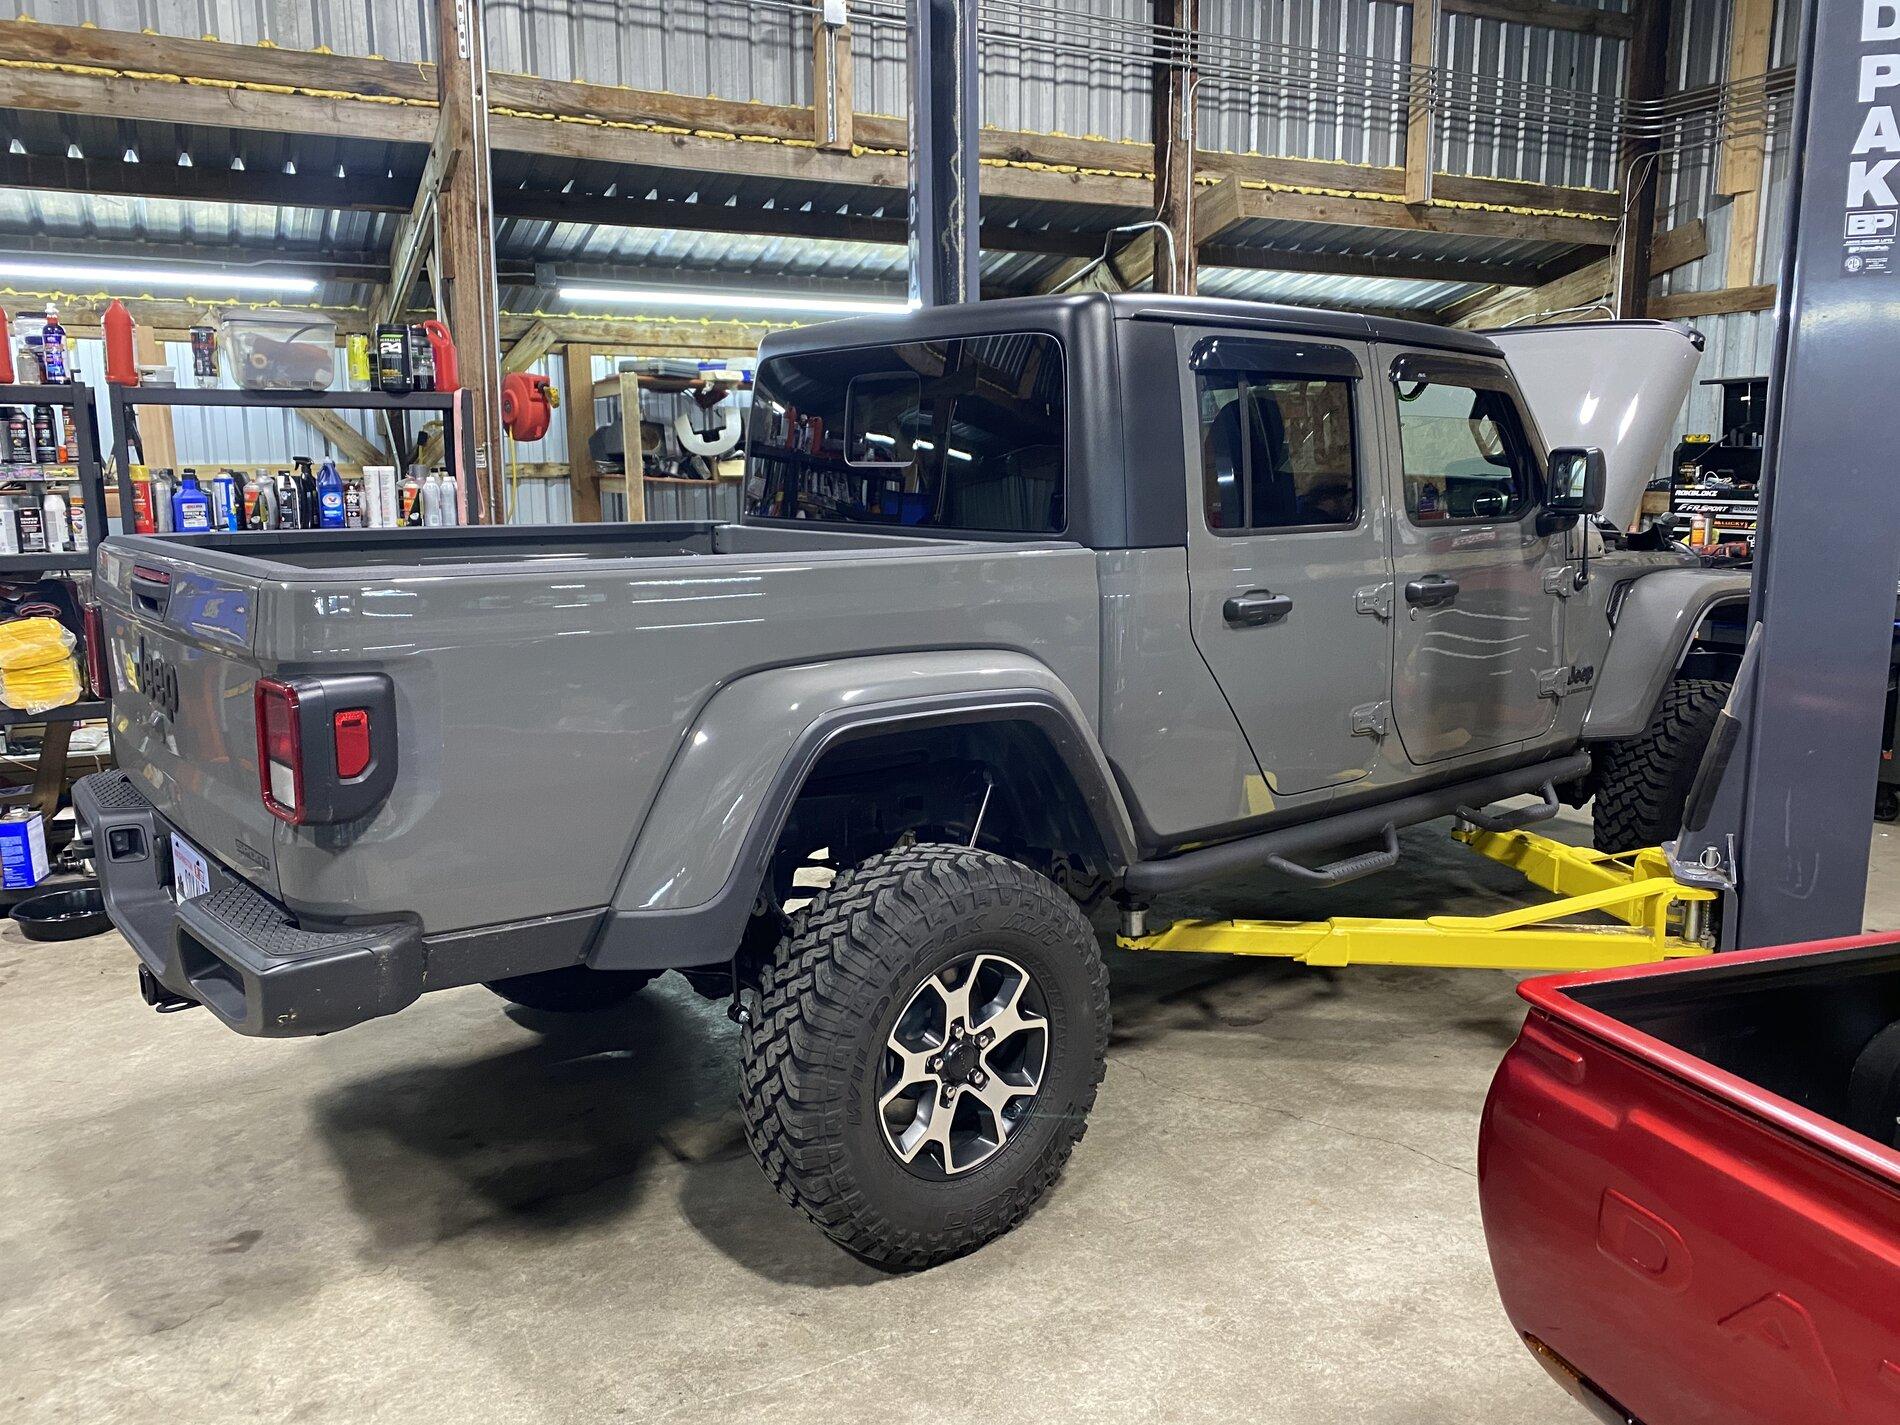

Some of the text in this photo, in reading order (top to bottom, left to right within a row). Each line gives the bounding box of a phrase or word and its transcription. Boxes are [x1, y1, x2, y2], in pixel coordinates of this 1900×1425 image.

[1847, 213, 1895, 236] BP
[137, 636, 180, 724] Jeep
[1567, 665, 1594, 686] Jeep
